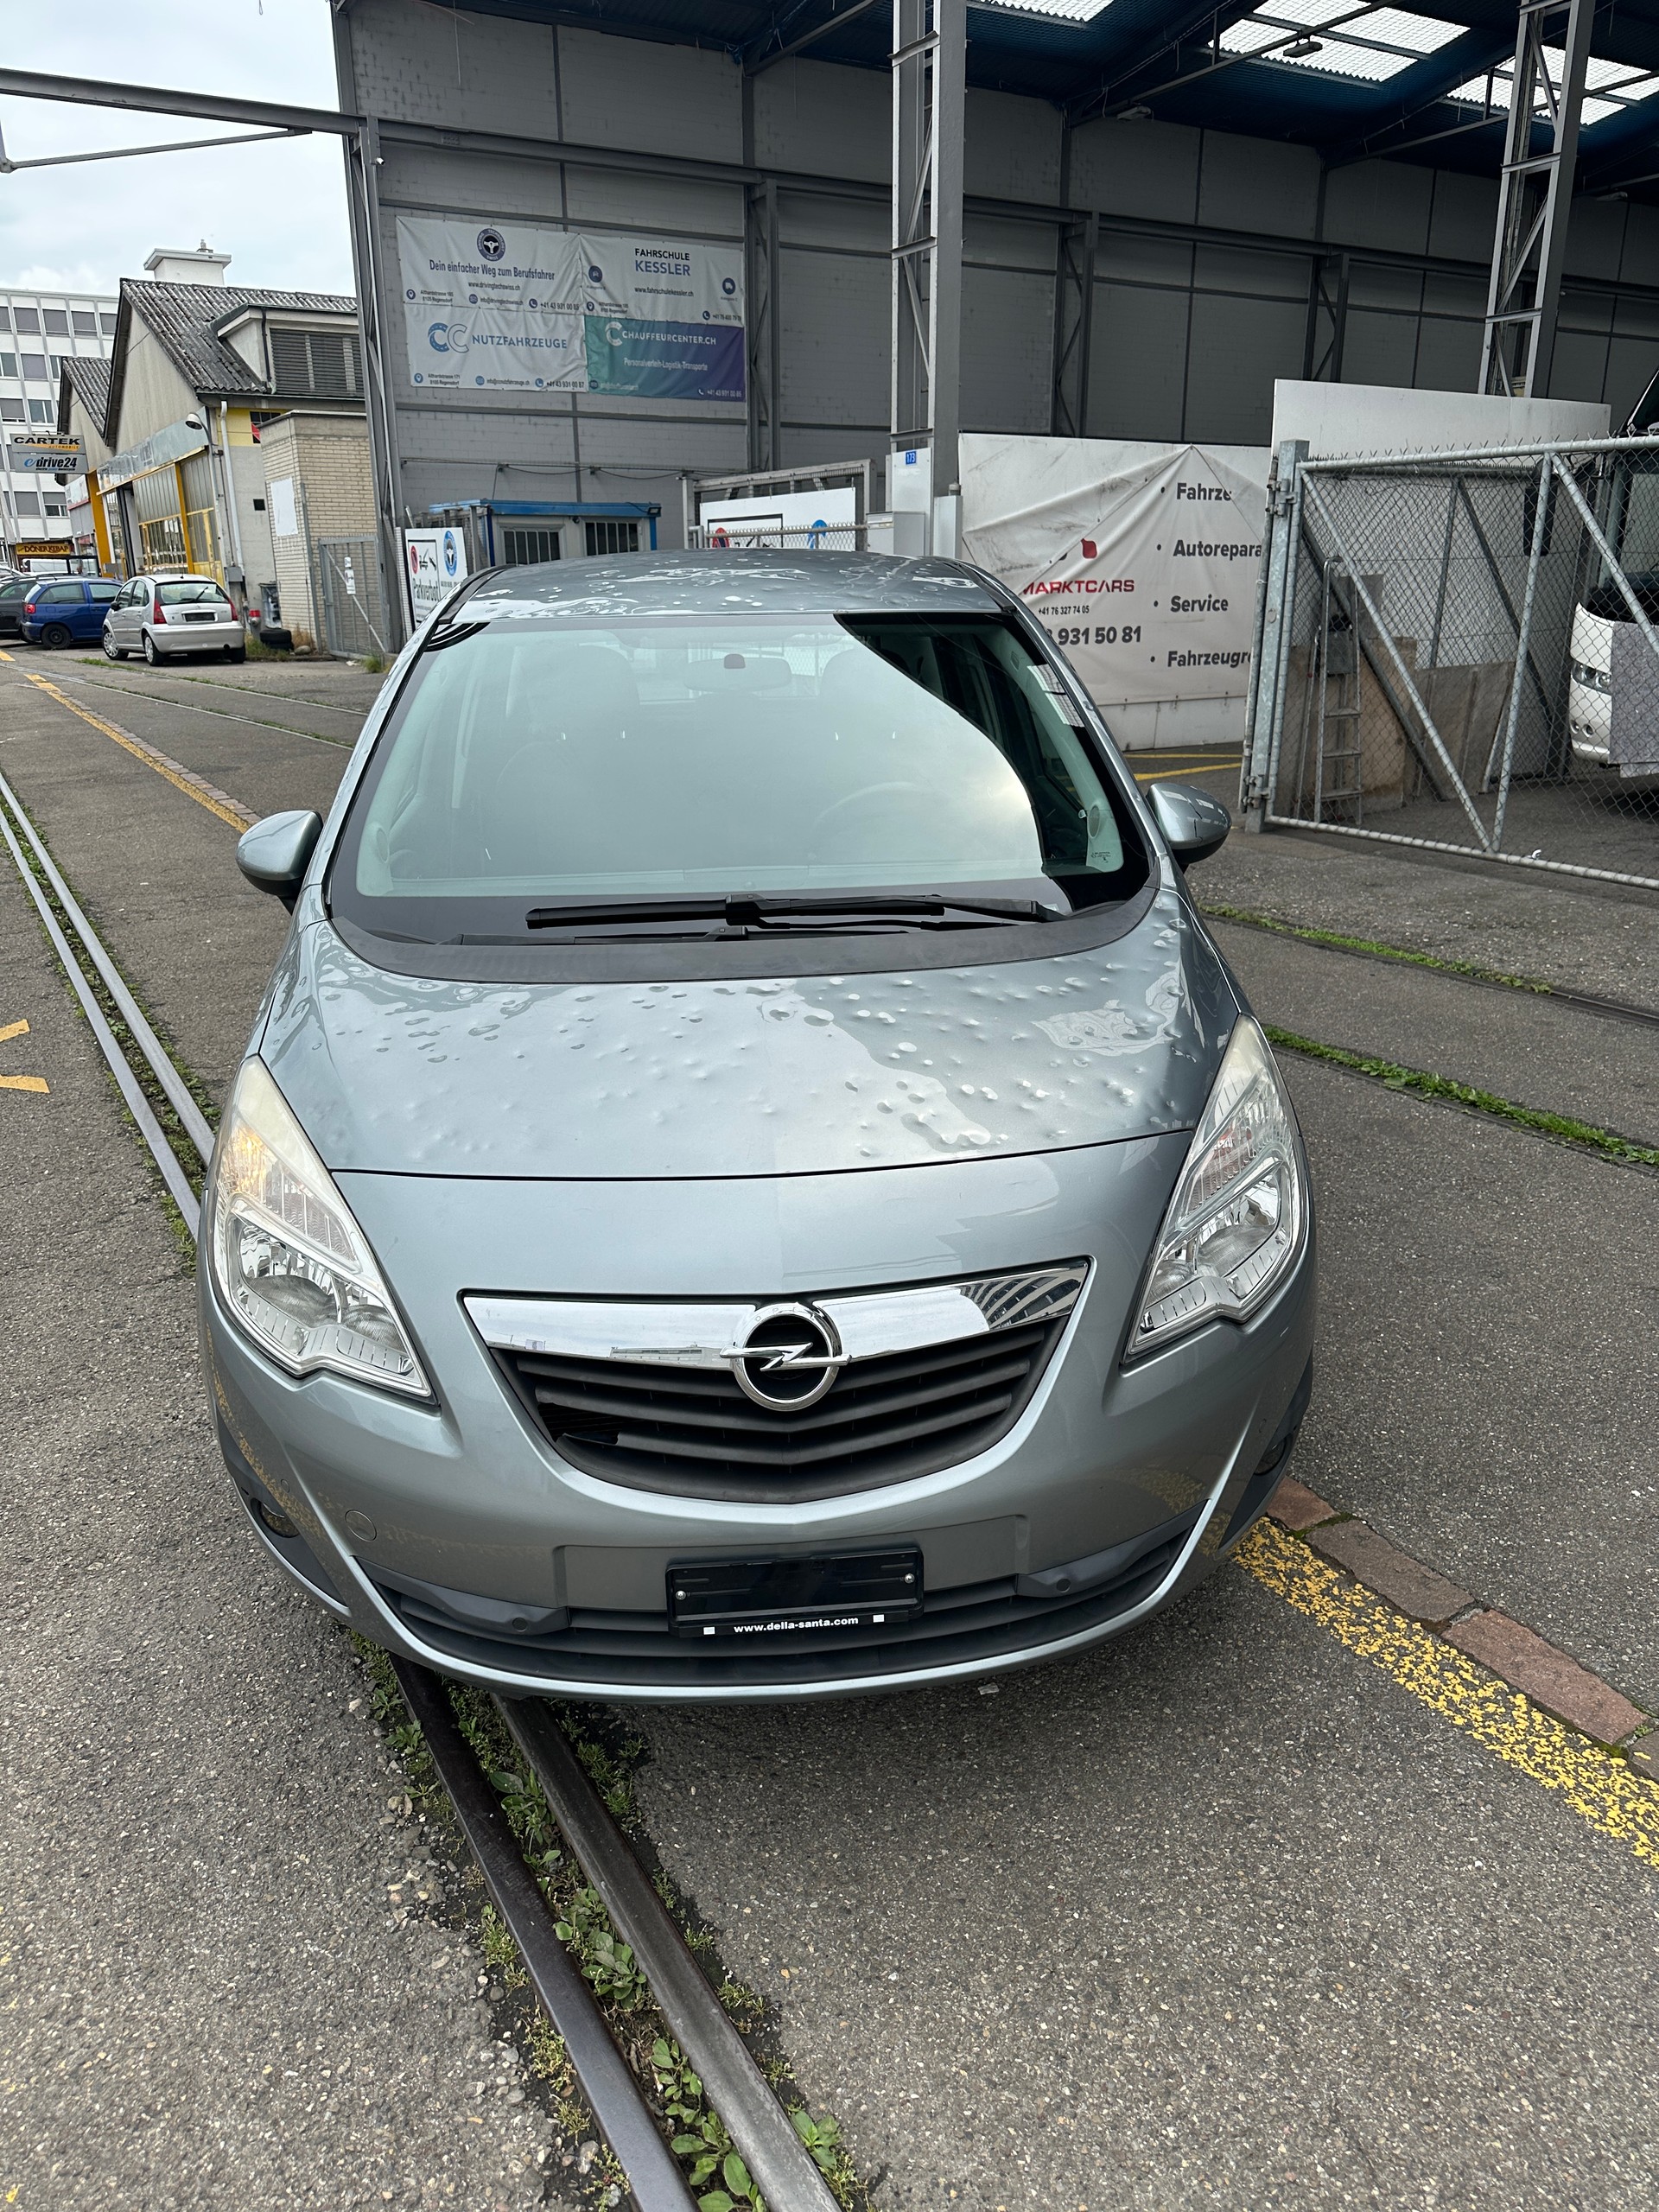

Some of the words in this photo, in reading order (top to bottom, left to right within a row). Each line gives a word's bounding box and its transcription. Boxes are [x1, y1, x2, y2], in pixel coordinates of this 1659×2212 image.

[634, 248, 690, 261] FAHRSCHULE
[429, 259, 446, 271] Dein
[448, 262, 480, 274] einfacher
[481, 264, 496, 277] Weg
[498, 268, 512, 276] zum
[513, 267, 555, 281] Berufsfahrer
[634, 260, 690, 276] KESSLER
[472, 334, 567, 349] NUTZFAHRZEUGE
[14, 436, 80, 445] CARTEK
[906, 452, 916, 463] 173
[1038, 607, 1049, 615] +41
[1051, 607, 1058, 615] 76
[1060, 607, 1071, 615] 327
[1072, 606, 1081, 614] 74
[1082, 605, 1090, 614] 05
[1170, 594, 1229, 613] Service
[1058, 627, 1090, 645] 931
[1095, 626, 1117, 645] 50
[1122, 626, 1141, 643] 81
[1167, 650, 1250, 668] Fahrzeugr
[734, 1618, 859, 1633] www.della-santa.com
